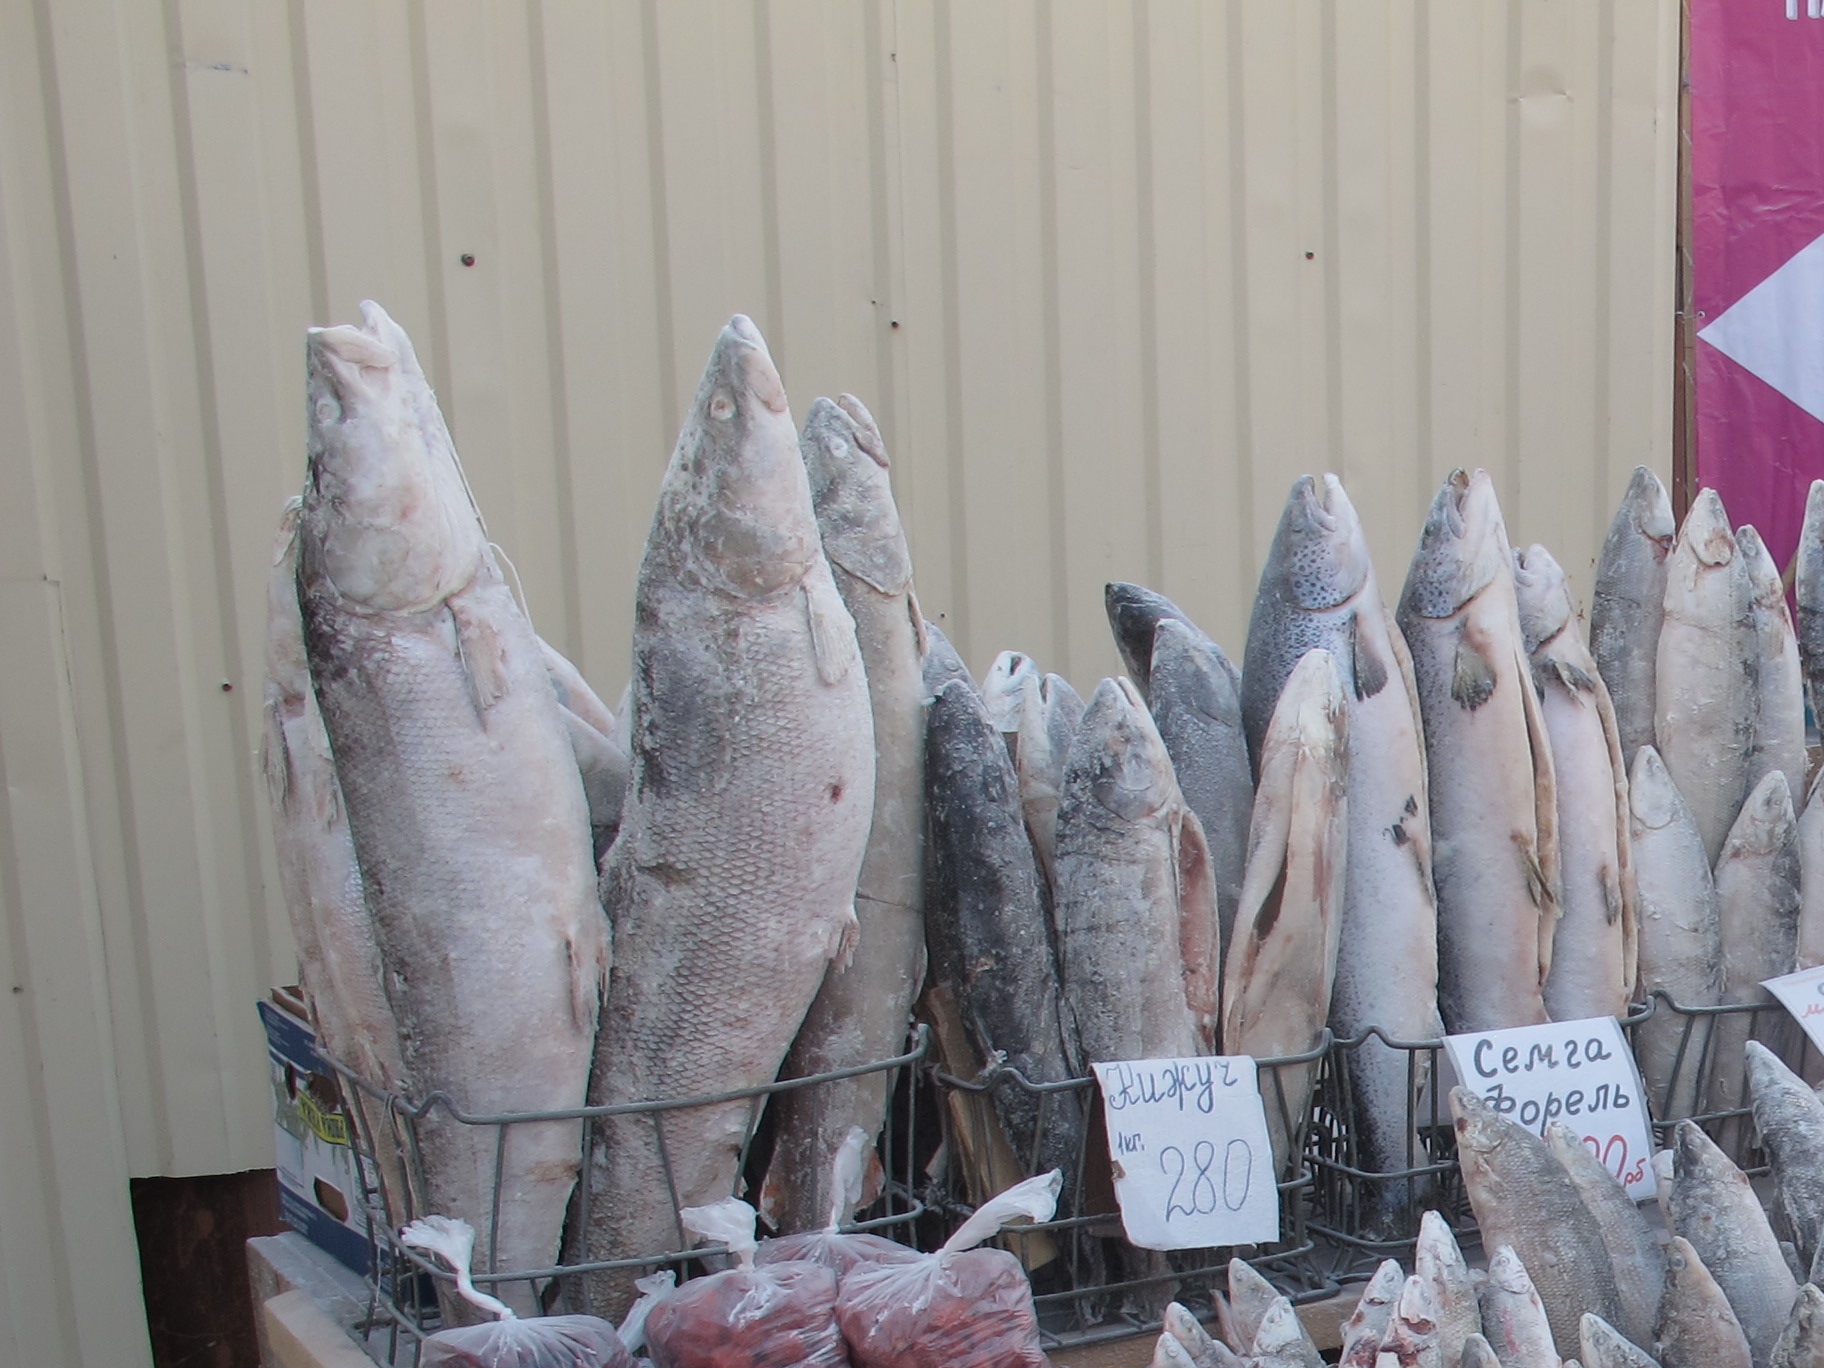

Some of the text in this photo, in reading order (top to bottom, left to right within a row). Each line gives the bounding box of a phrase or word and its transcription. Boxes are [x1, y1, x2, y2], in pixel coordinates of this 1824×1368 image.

[1106, 1058, 1240, 1113] Кижуч
[1472, 1036, 1613, 1080] Семга
[1483, 1083, 1631, 1138] Форель
[1159, 1138, 1253, 1222] 280
